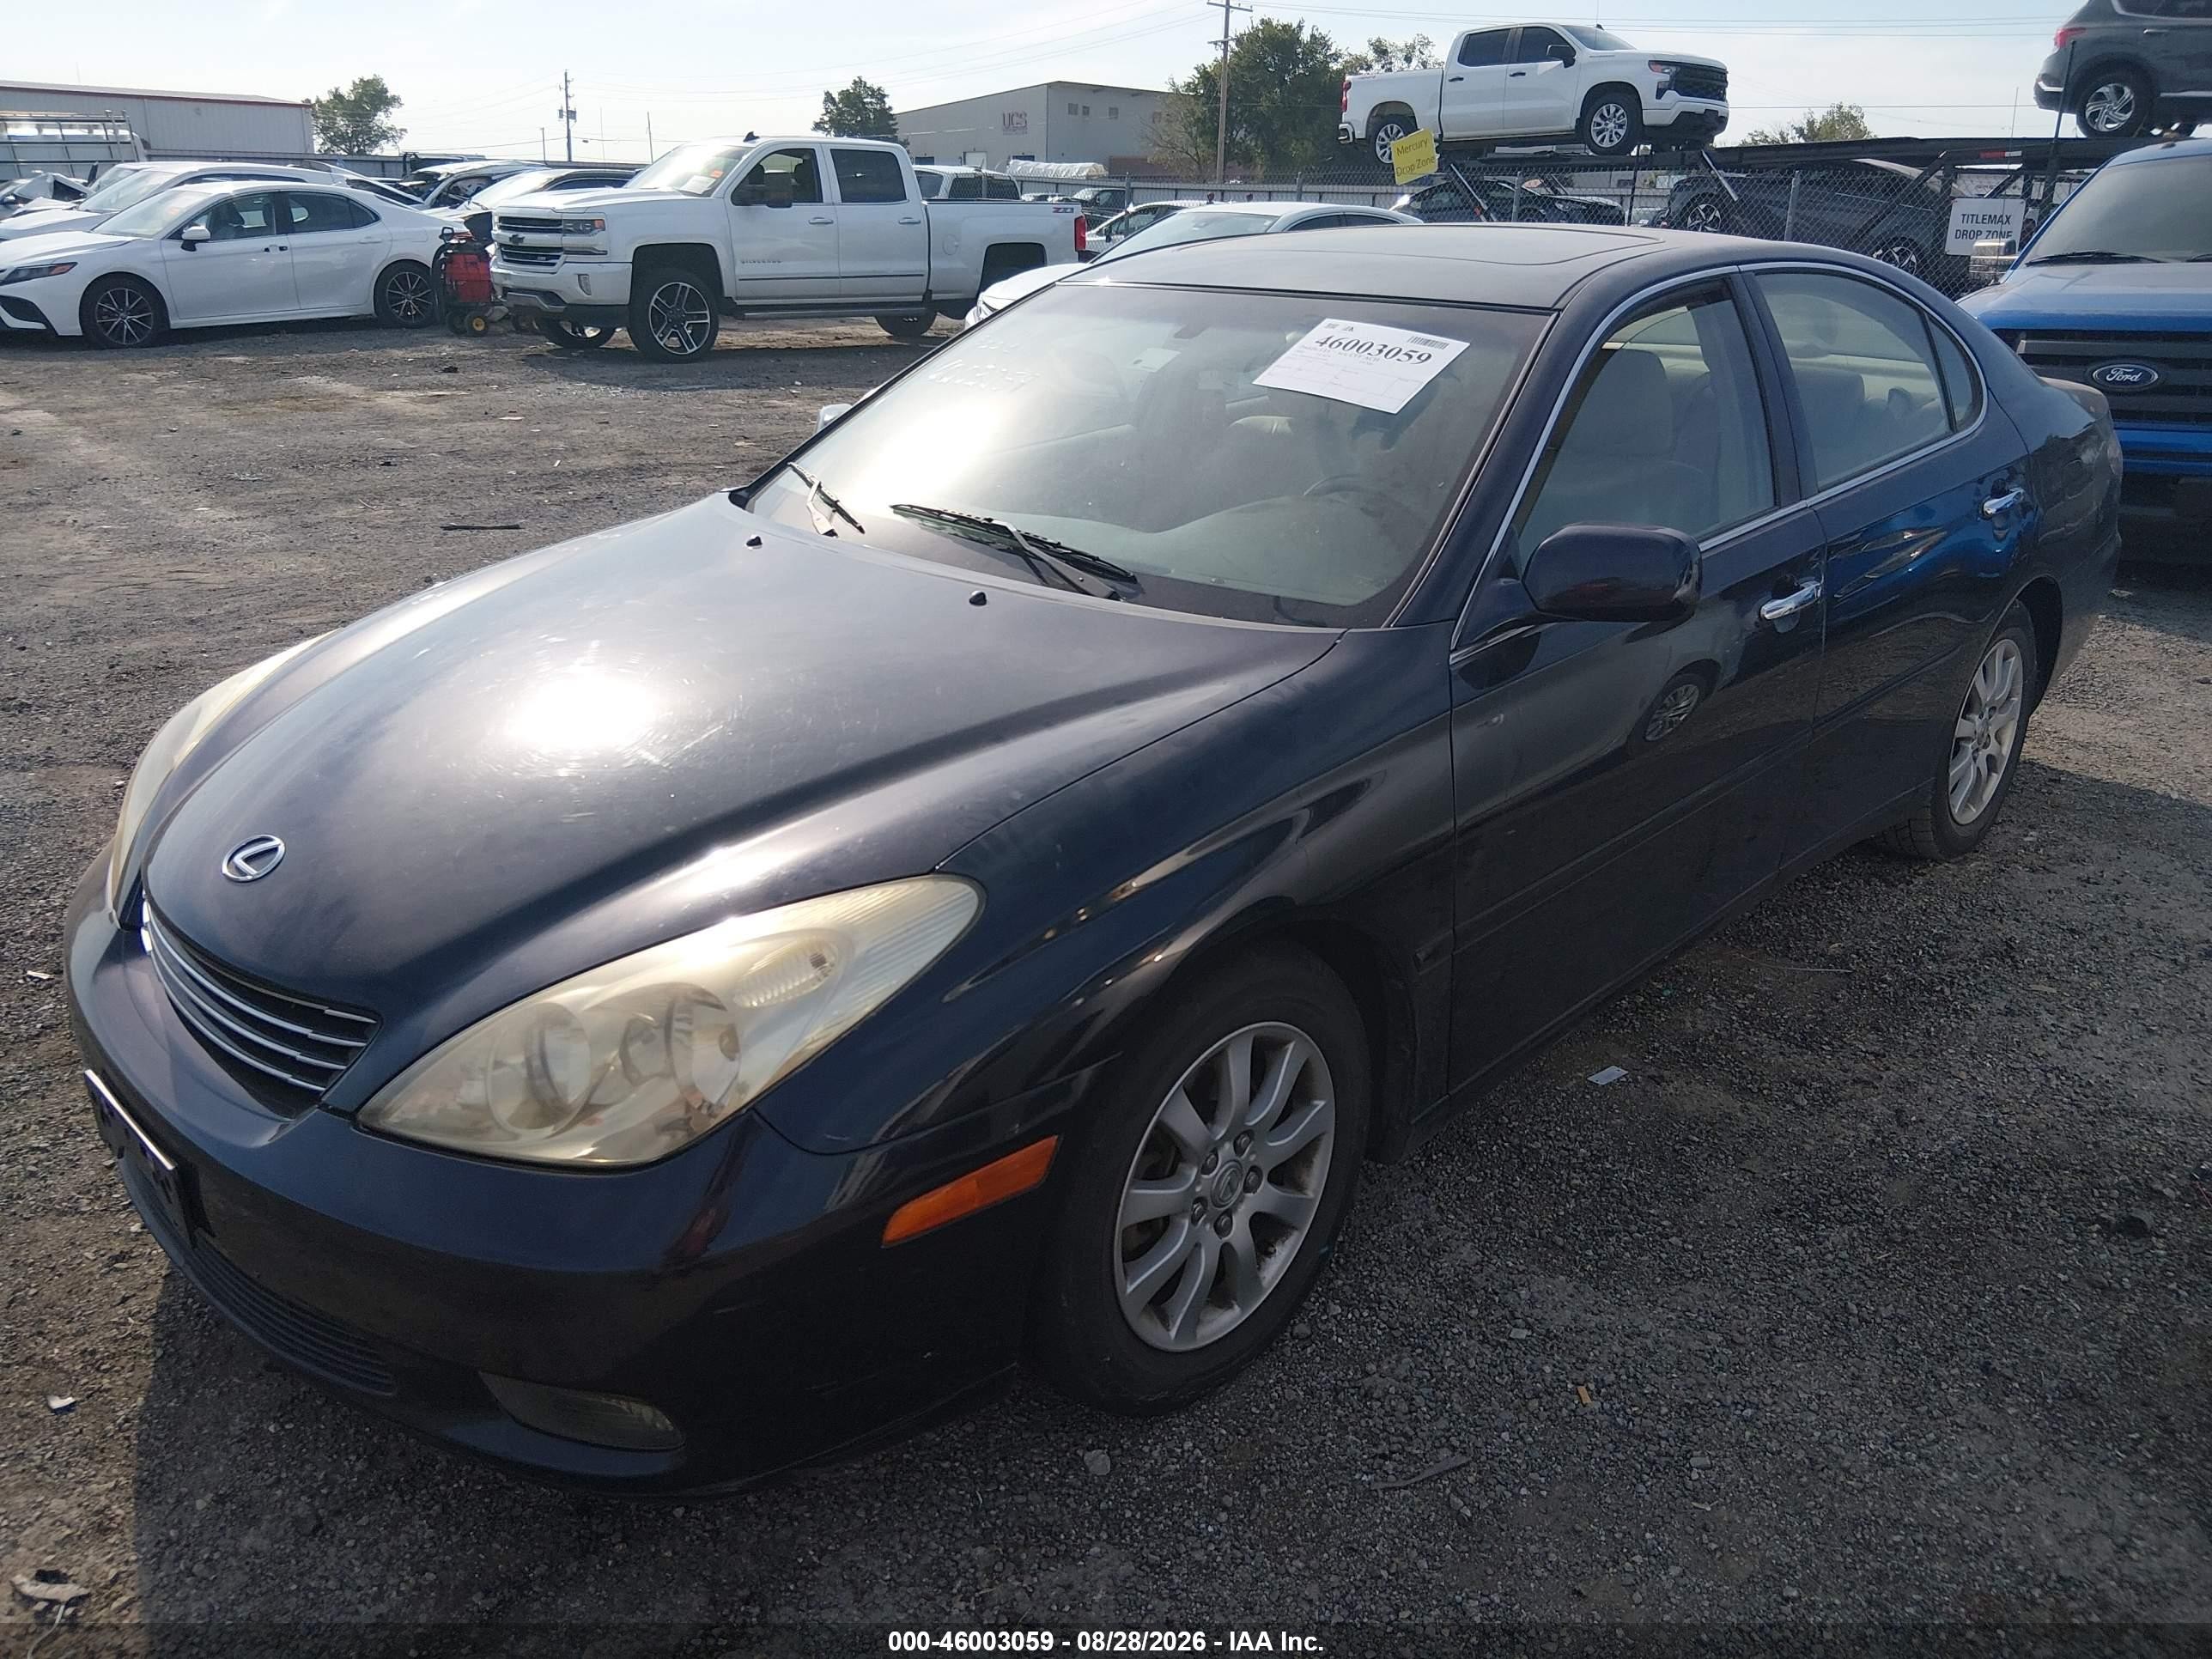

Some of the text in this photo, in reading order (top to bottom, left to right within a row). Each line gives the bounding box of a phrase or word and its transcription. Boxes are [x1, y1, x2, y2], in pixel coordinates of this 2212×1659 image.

[1396, 138, 1427, 156] Mercury
[1395, 157, 1435, 177] Drop Zone
[1961, 213, 2013, 226] TITLEMAX
[1954, 228, 1983, 240] DROP
[1316, 335, 1432, 365] 46003059
[2106, 368, 2142, 381] Ford
